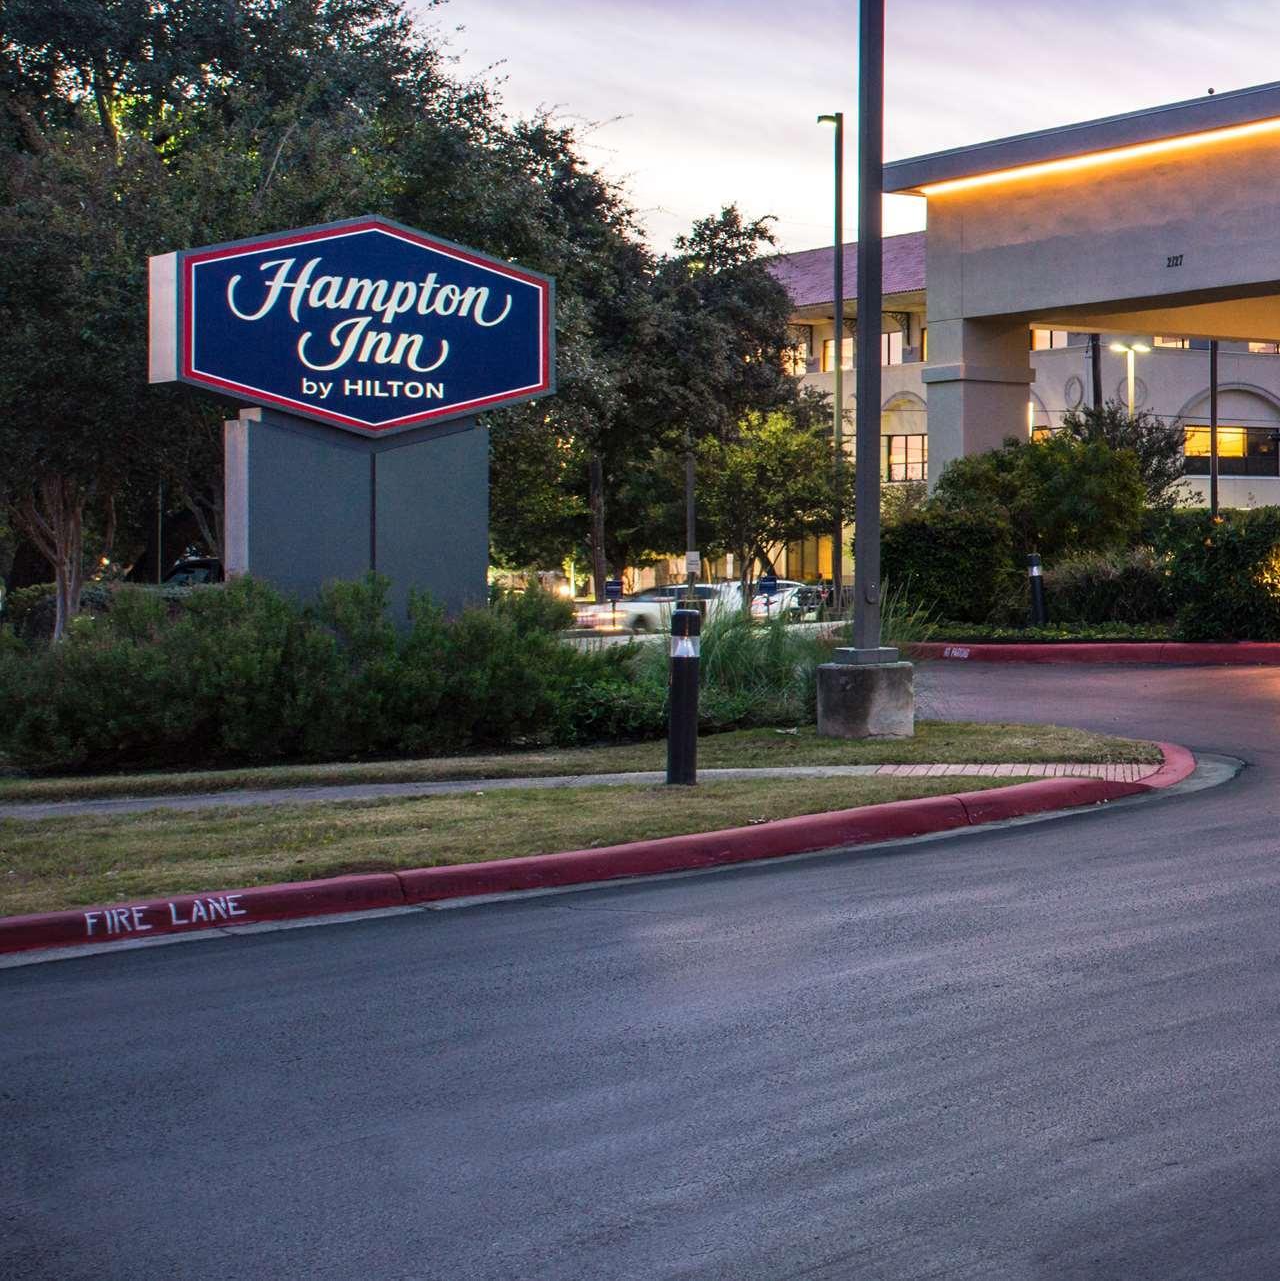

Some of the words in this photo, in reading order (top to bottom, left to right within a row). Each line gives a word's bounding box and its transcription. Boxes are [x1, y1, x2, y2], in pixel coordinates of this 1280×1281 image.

[227, 257, 512, 327] Hampton
[297, 316, 449, 373] Inn
[302, 377, 333, 399] by
[343, 379, 444, 399] HILTON
[84, 905, 152, 936] FIRE
[168, 894, 247, 925] LANE
